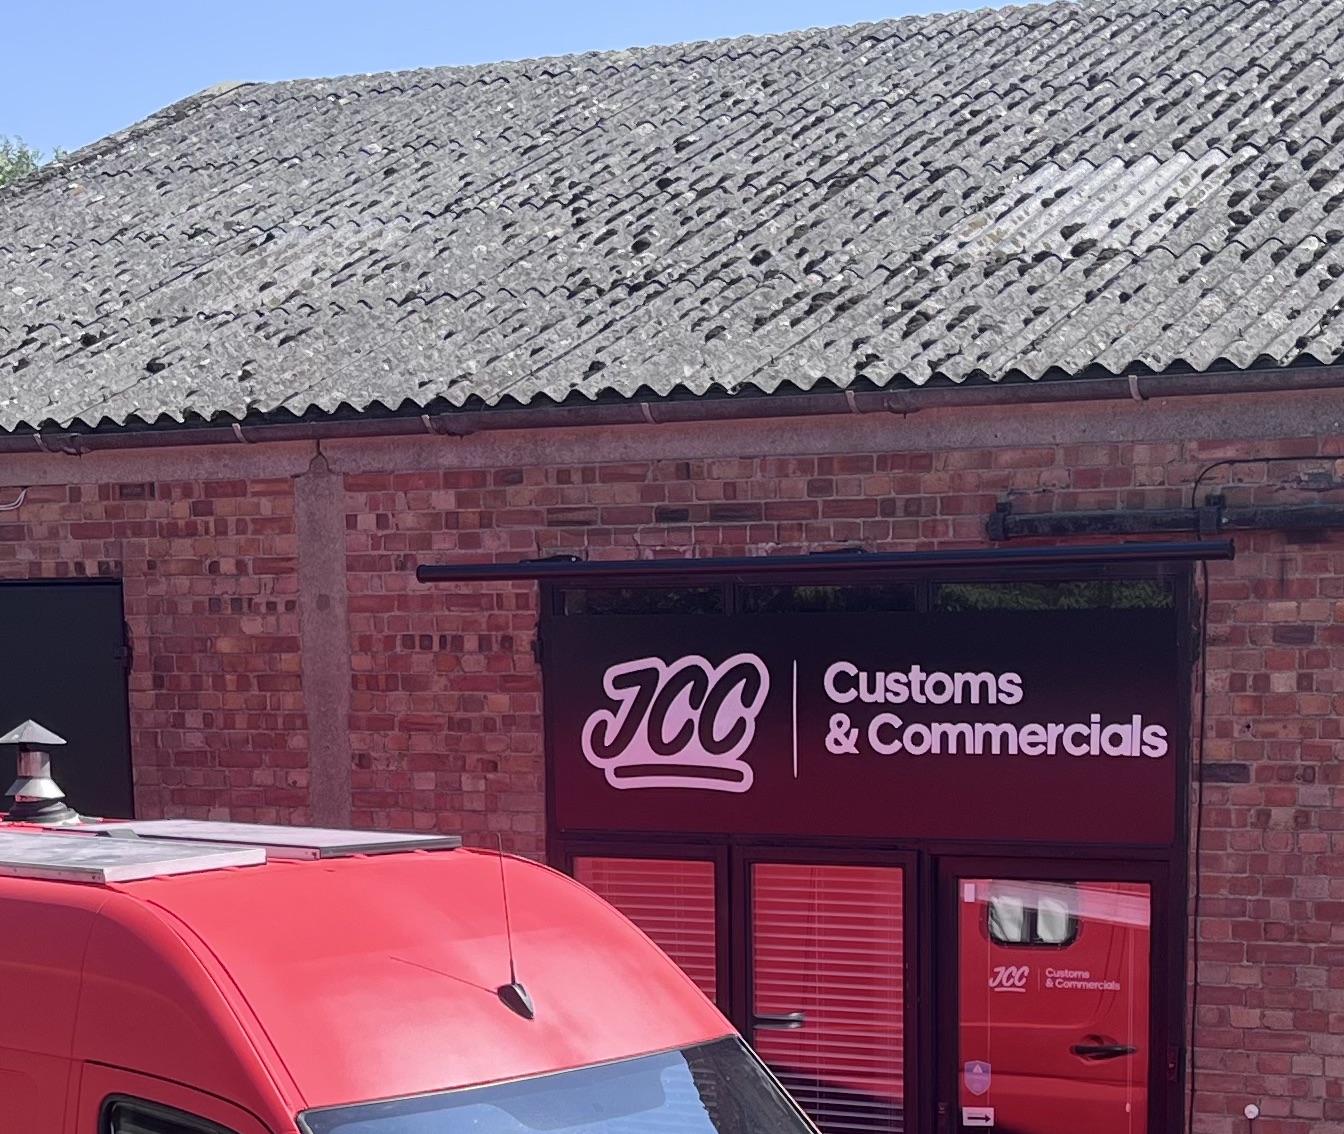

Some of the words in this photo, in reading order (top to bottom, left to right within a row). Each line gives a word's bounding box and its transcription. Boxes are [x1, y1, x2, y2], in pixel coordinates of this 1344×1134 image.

[824, 661, 1023, 705] Customs
[583, 653, 769, 770] JCC
[825, 712, 860, 755] &
[868, 713, 1168, 758] Commercials
[988, 966, 1030, 989] JCC
[1045, 968, 1090, 979] Customs
[1045, 979, 1054, 988] &
[1055, 979, 1121, 991] Commercials
